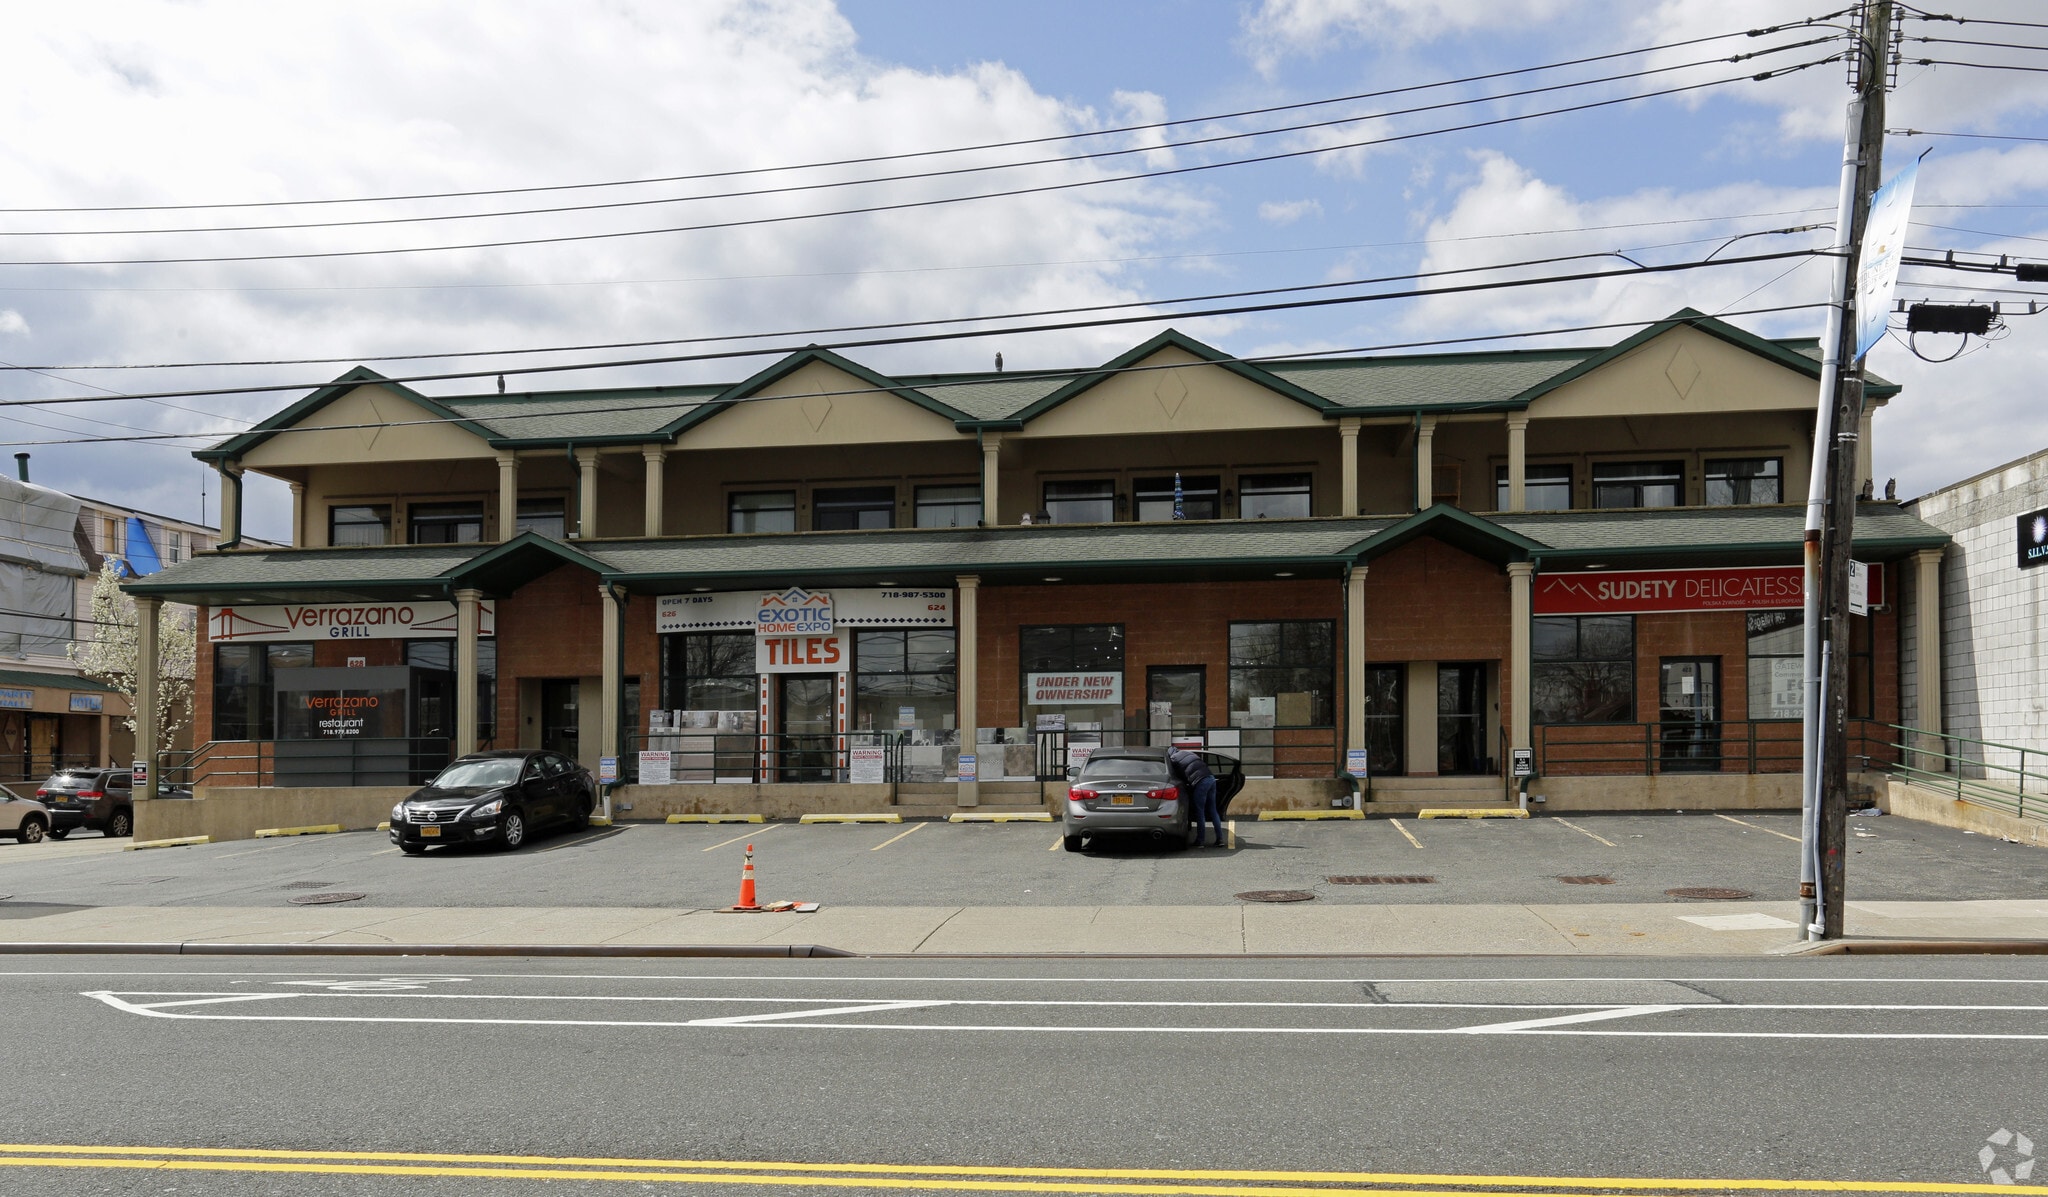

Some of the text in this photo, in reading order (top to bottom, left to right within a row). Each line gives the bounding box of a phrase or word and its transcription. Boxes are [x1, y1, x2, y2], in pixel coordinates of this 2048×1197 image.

[1598, 580, 1677, 600] SUDETY
[284, 606, 414, 629] Verrazano
[758, 607, 831, 622] EXOTIC
[330, 626, 370, 638] GRILL
[765, 638, 840, 665] TILES
[1036, 676, 1113, 687] UNDER NEW
[1035, 689, 1113, 700] OWNERSHIP
[319, 718, 363, 728] restaurant
